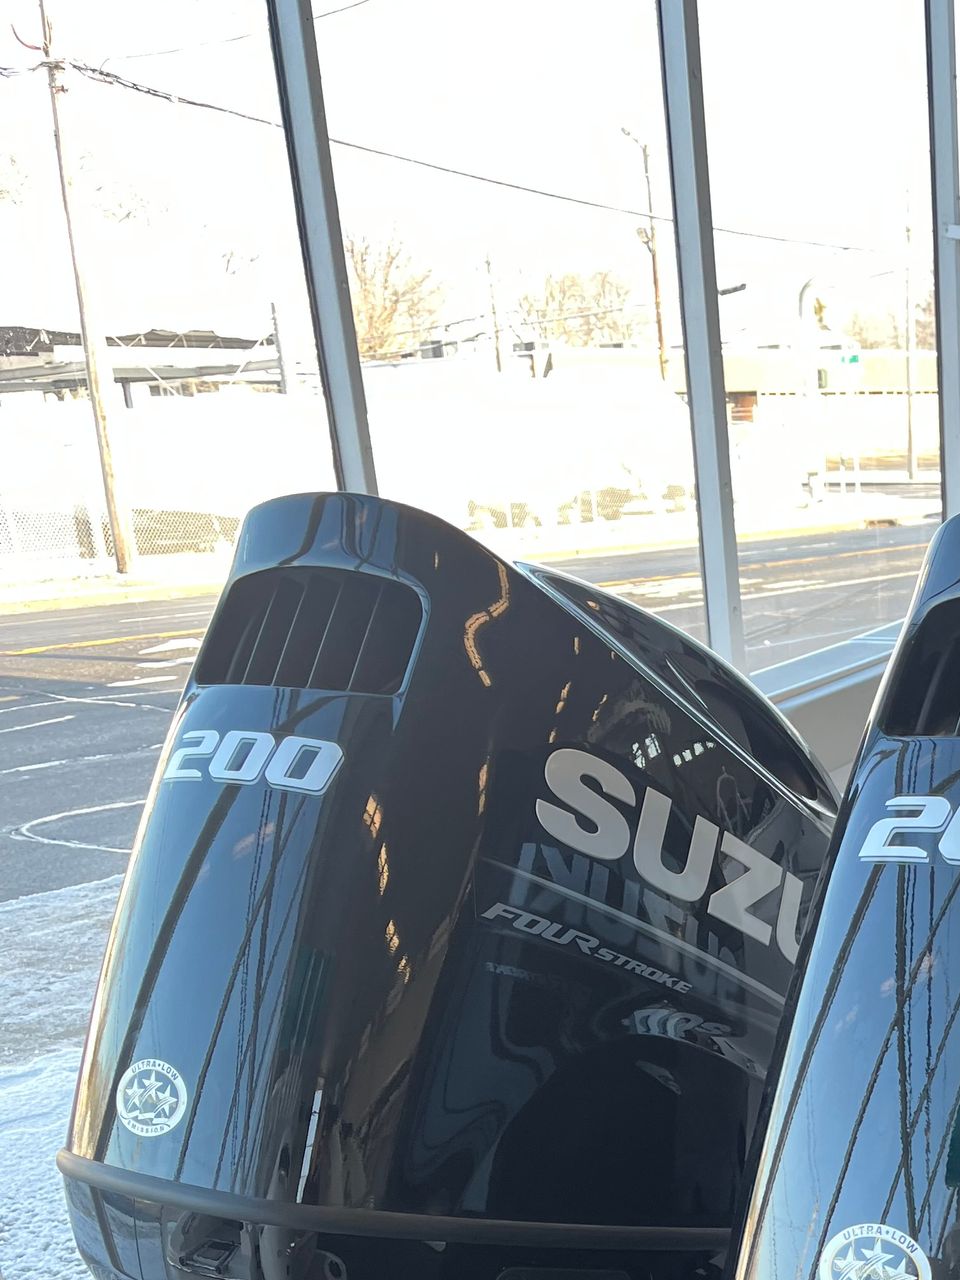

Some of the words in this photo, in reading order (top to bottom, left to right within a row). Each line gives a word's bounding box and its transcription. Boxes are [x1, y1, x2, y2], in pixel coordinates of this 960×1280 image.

[164, 730, 344, 796] 200
[481, 902, 600, 955] FOUR
[595, 948, 692, 994] STROKE
[127, 1121, 165, 1134] EMISSION
